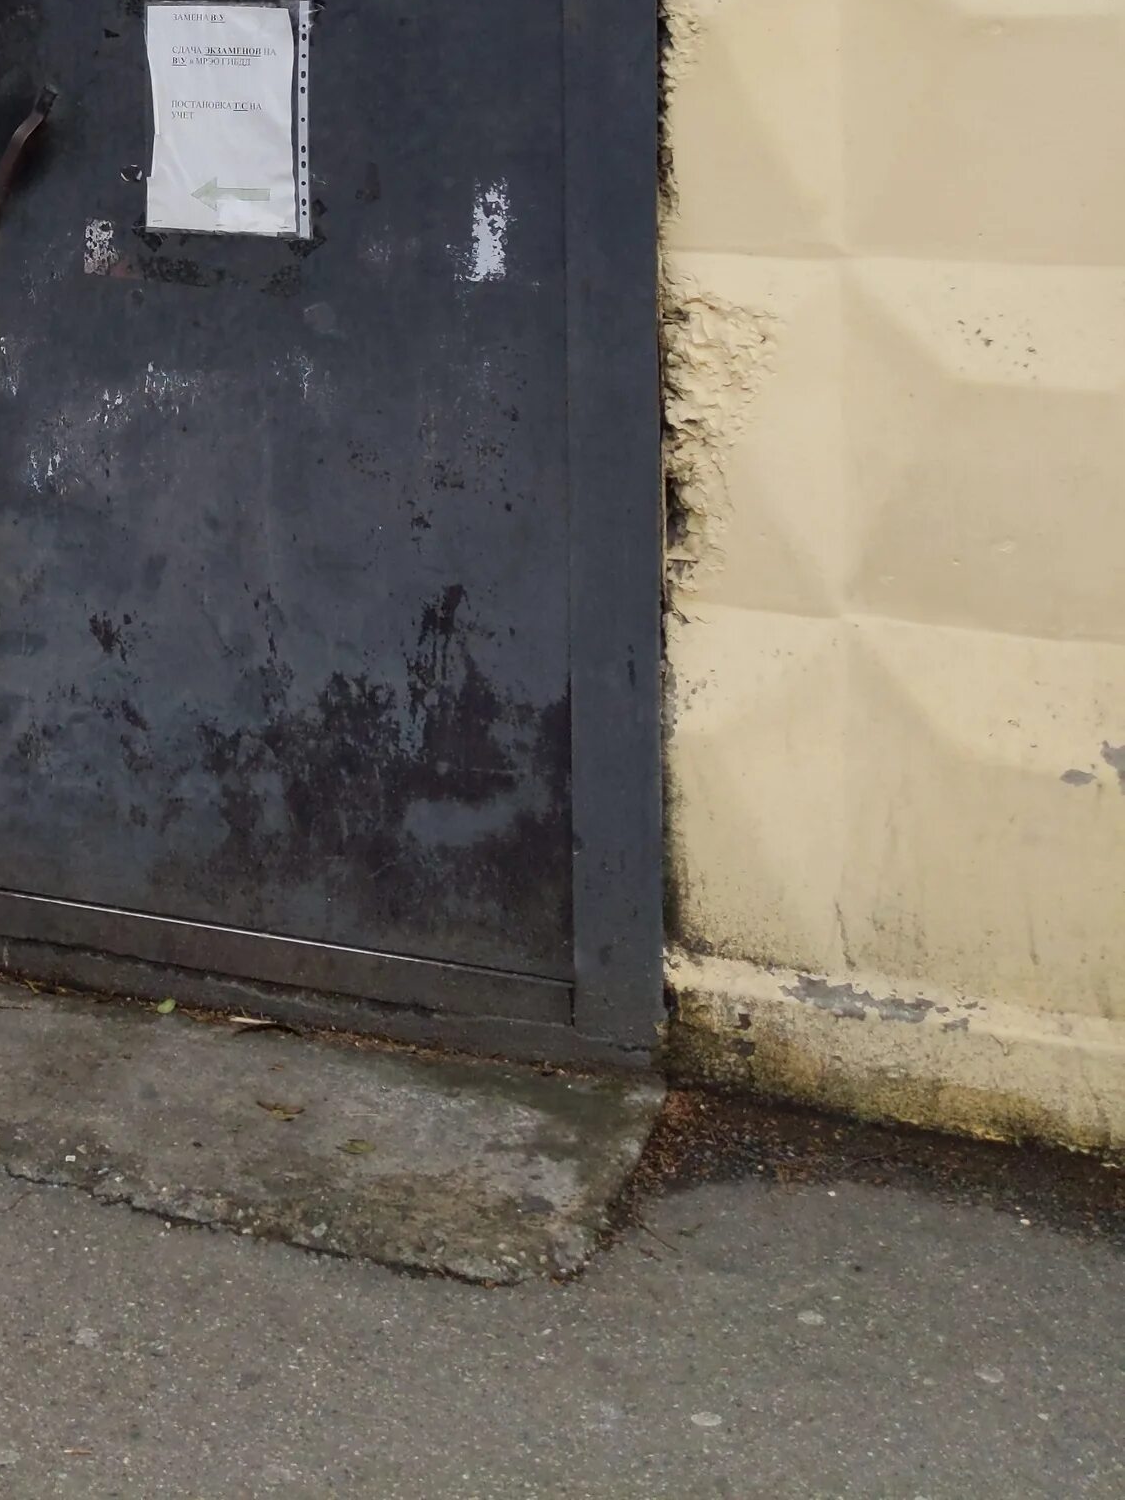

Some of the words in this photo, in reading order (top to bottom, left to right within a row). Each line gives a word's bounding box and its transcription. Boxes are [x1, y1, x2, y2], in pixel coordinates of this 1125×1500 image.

[173, 13, 209, 22] ЗАМЕНА
[172, 45, 202, 55] СДАЧА
[204, 46, 262, 56] ЭКЗАМЕНОВ
[171, 100, 232, 110] ПОСТАНОВКА
